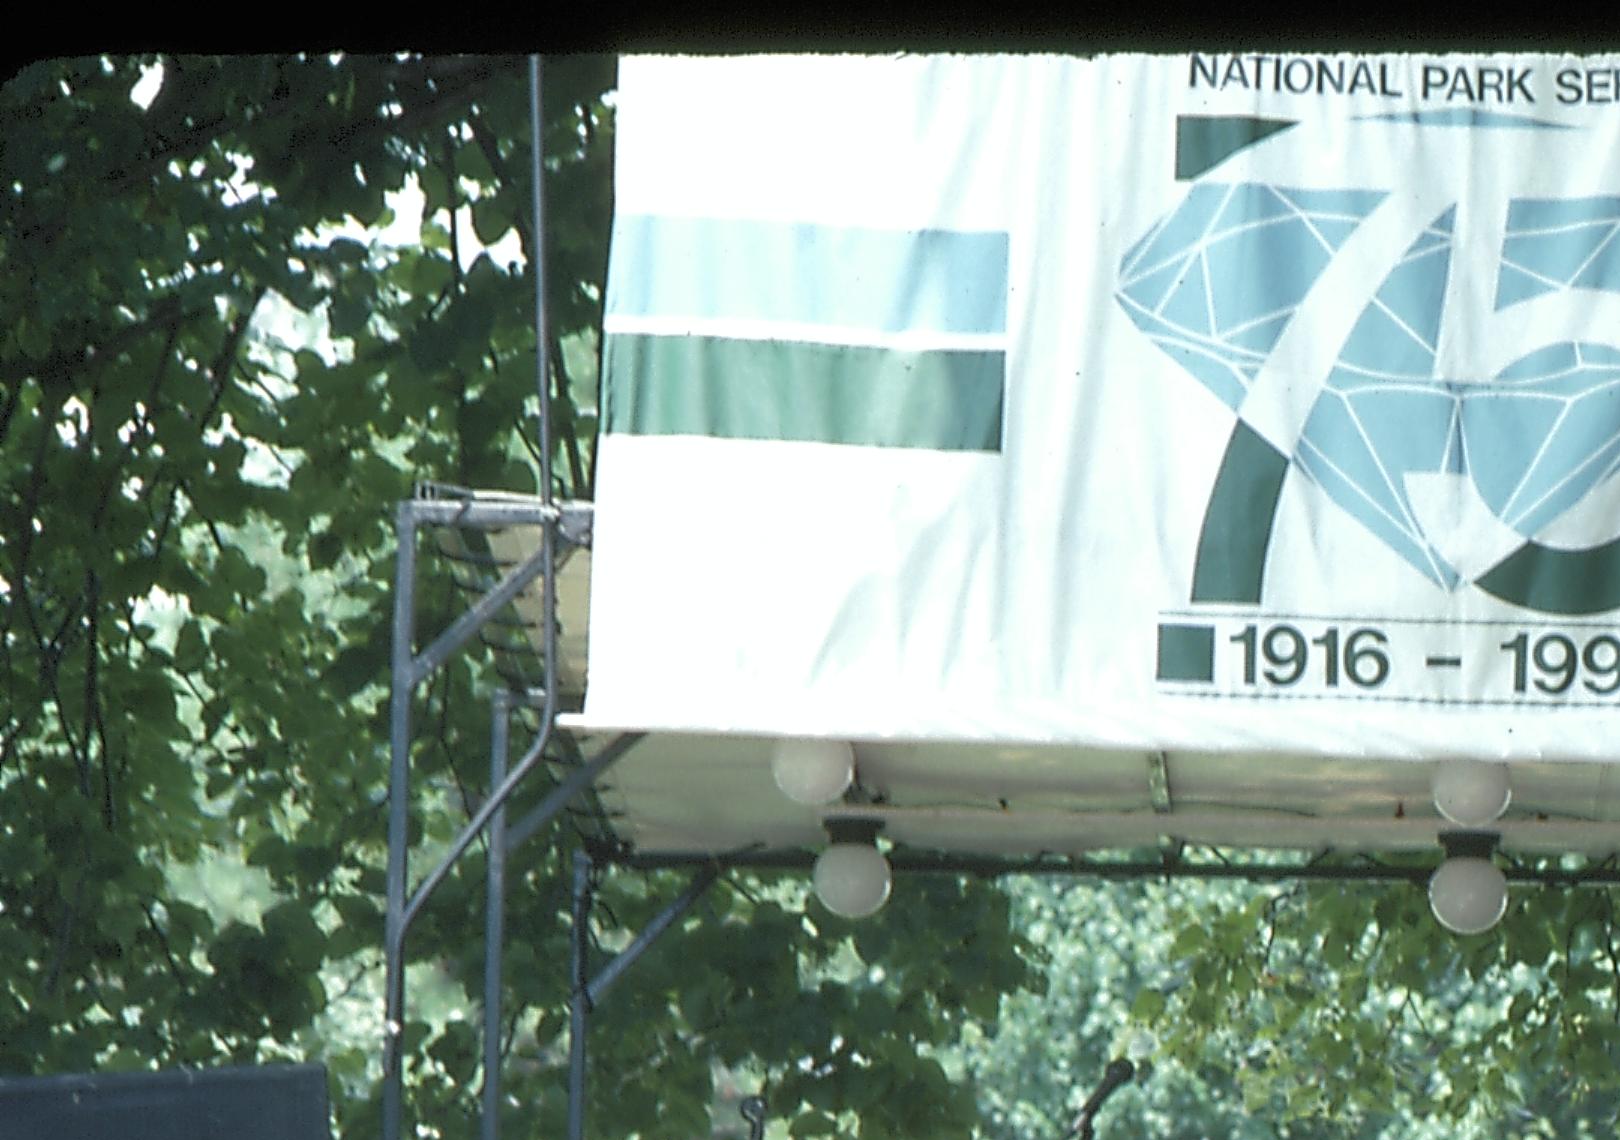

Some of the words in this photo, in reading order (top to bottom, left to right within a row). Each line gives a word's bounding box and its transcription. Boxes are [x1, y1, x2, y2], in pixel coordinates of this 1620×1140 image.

[1188, 55, 1402, 98] NATIONAL
[1421, 65, 1535, 103] PARK
[1229, 625, 1391, 688] 1916
